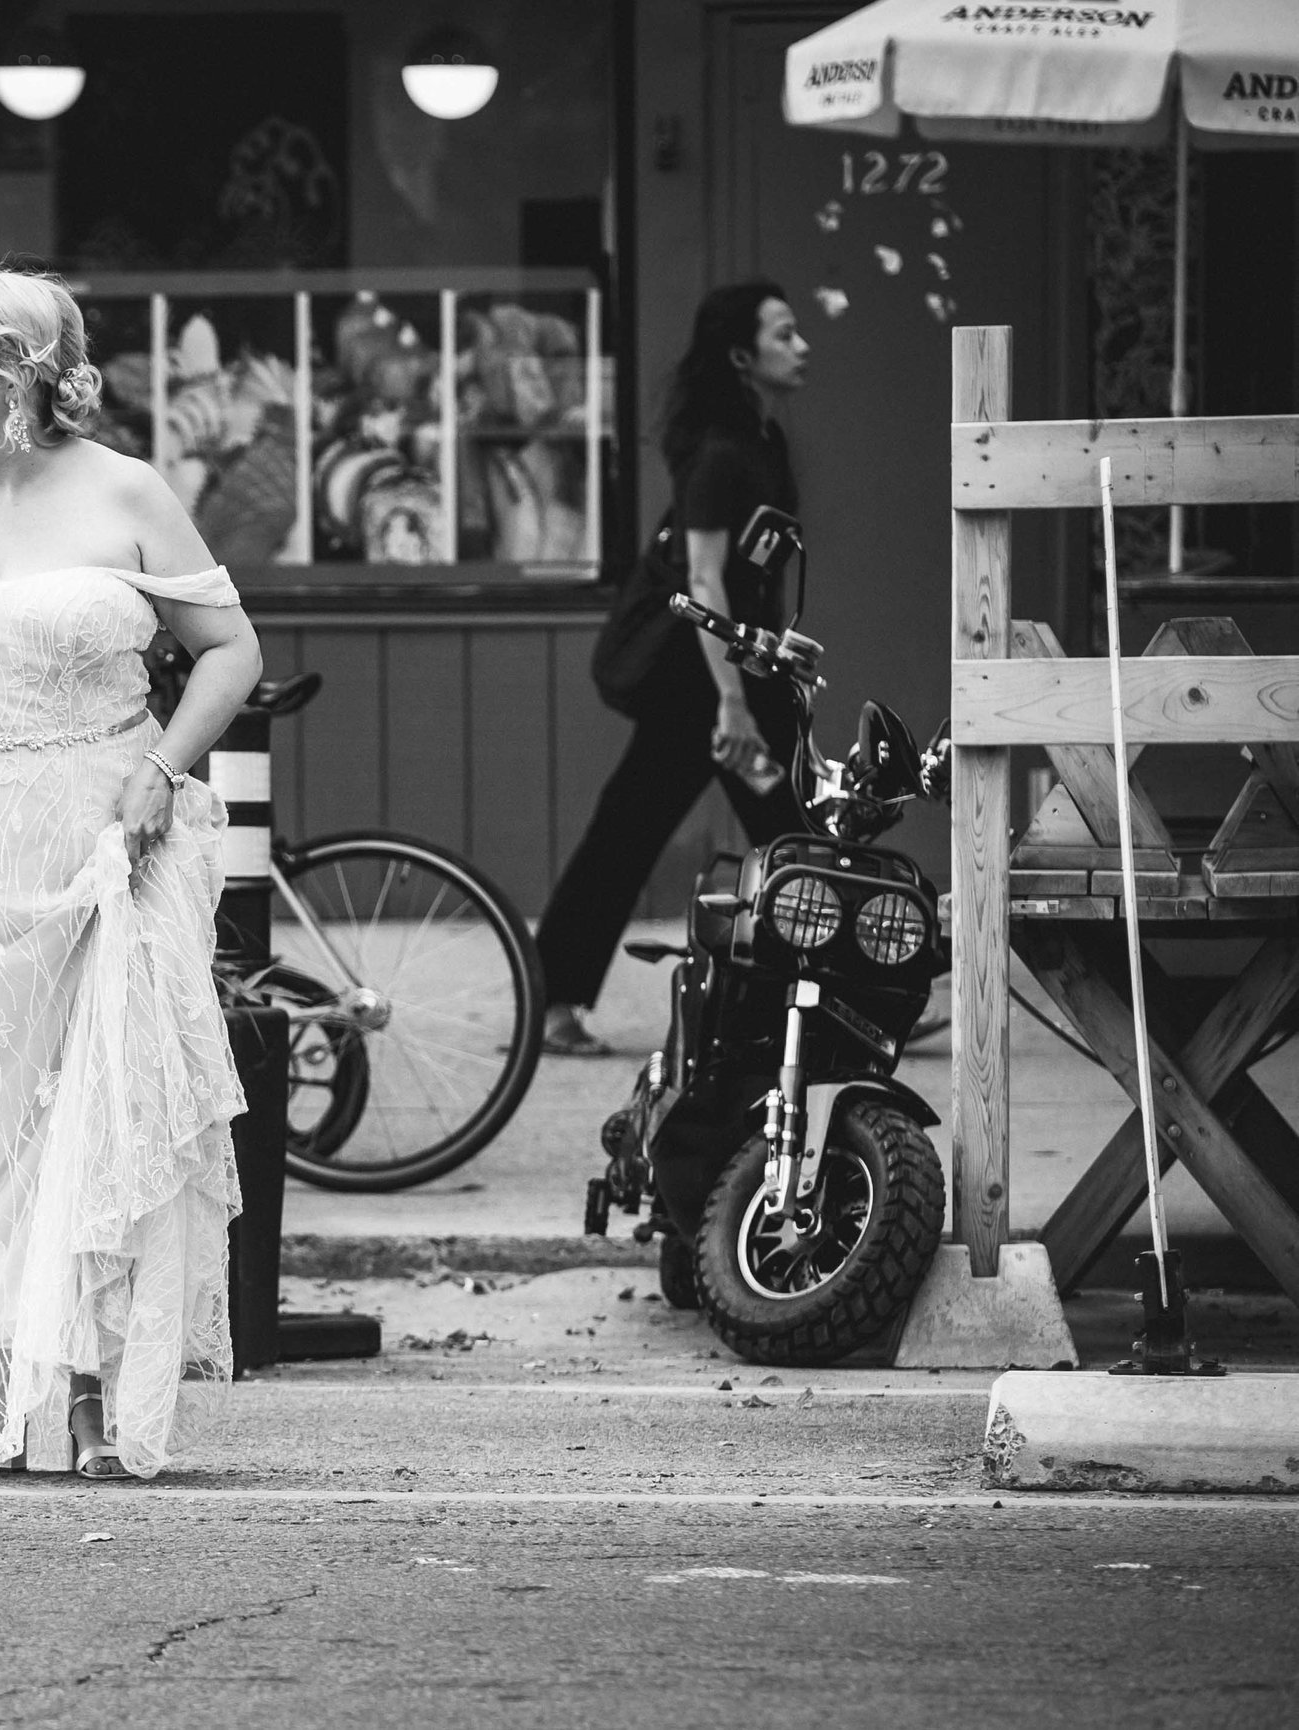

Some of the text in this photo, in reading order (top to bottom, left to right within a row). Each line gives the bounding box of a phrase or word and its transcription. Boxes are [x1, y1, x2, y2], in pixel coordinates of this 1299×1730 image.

[941, 5, 1156, 28] ANDERSON
[1222, 71, 1299, 100] AND
[841, 151, 947, 194] 1272
